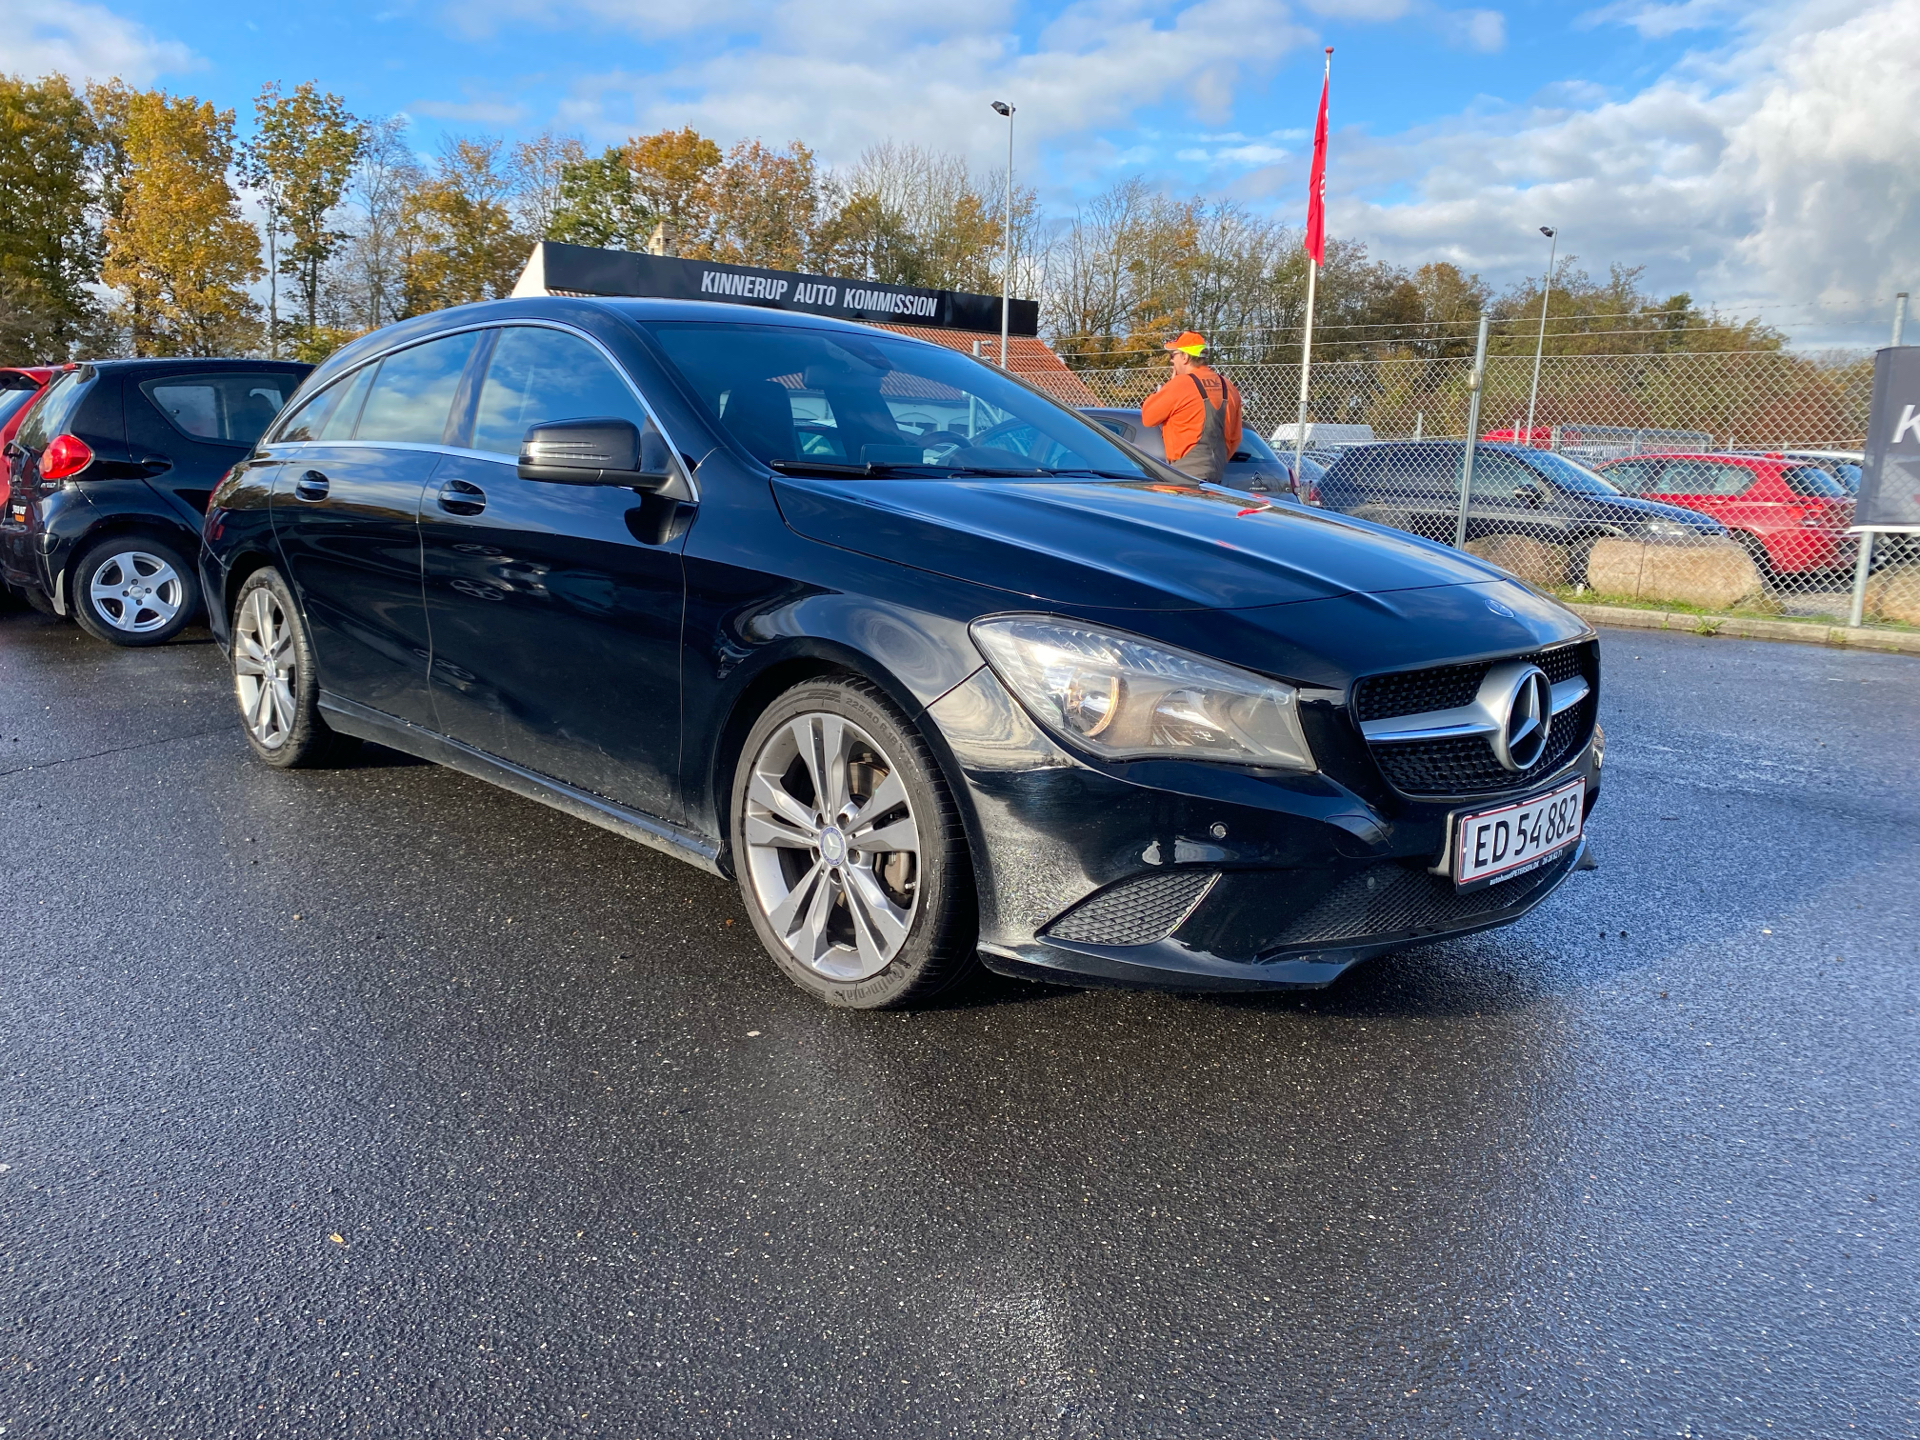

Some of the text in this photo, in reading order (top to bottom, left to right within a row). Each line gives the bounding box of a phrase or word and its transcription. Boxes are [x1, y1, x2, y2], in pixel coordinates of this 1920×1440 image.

[701, 271, 937, 317] KINNERUP AUTO KOMMISSION
[845, 697, 880, 725] 225/40
